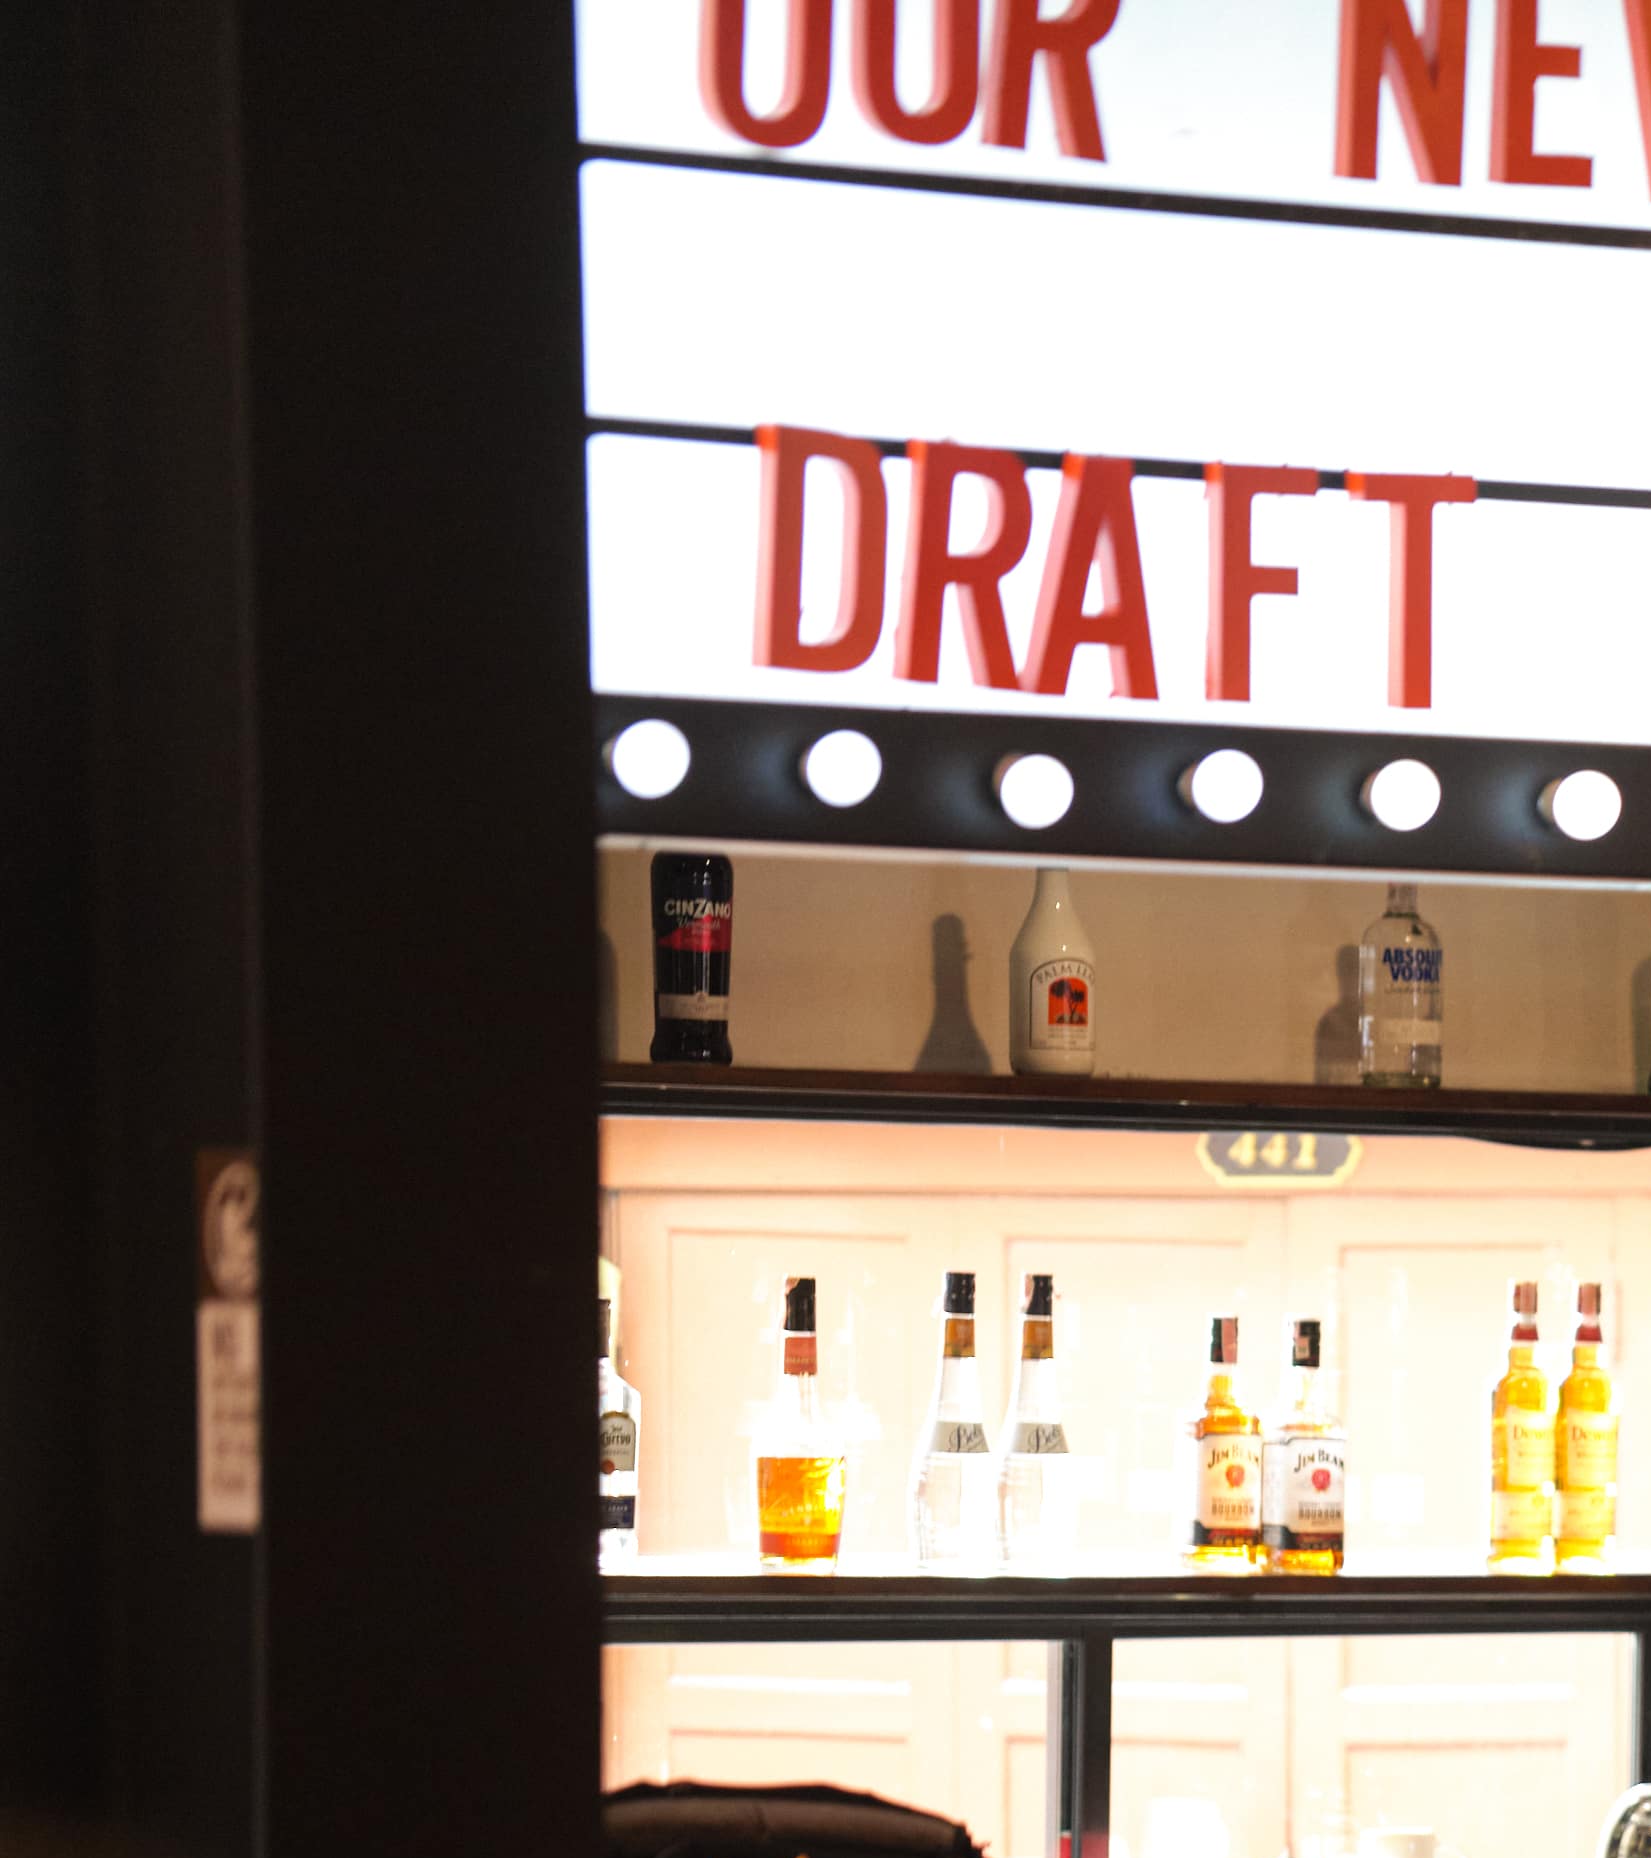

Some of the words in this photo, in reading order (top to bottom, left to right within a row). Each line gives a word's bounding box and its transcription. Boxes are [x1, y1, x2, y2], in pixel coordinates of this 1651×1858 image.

[700, 0, 1122, 163] OUR
[752, 424, 1478, 710] DRAFT
[664, 898, 732, 919] CINZANO
